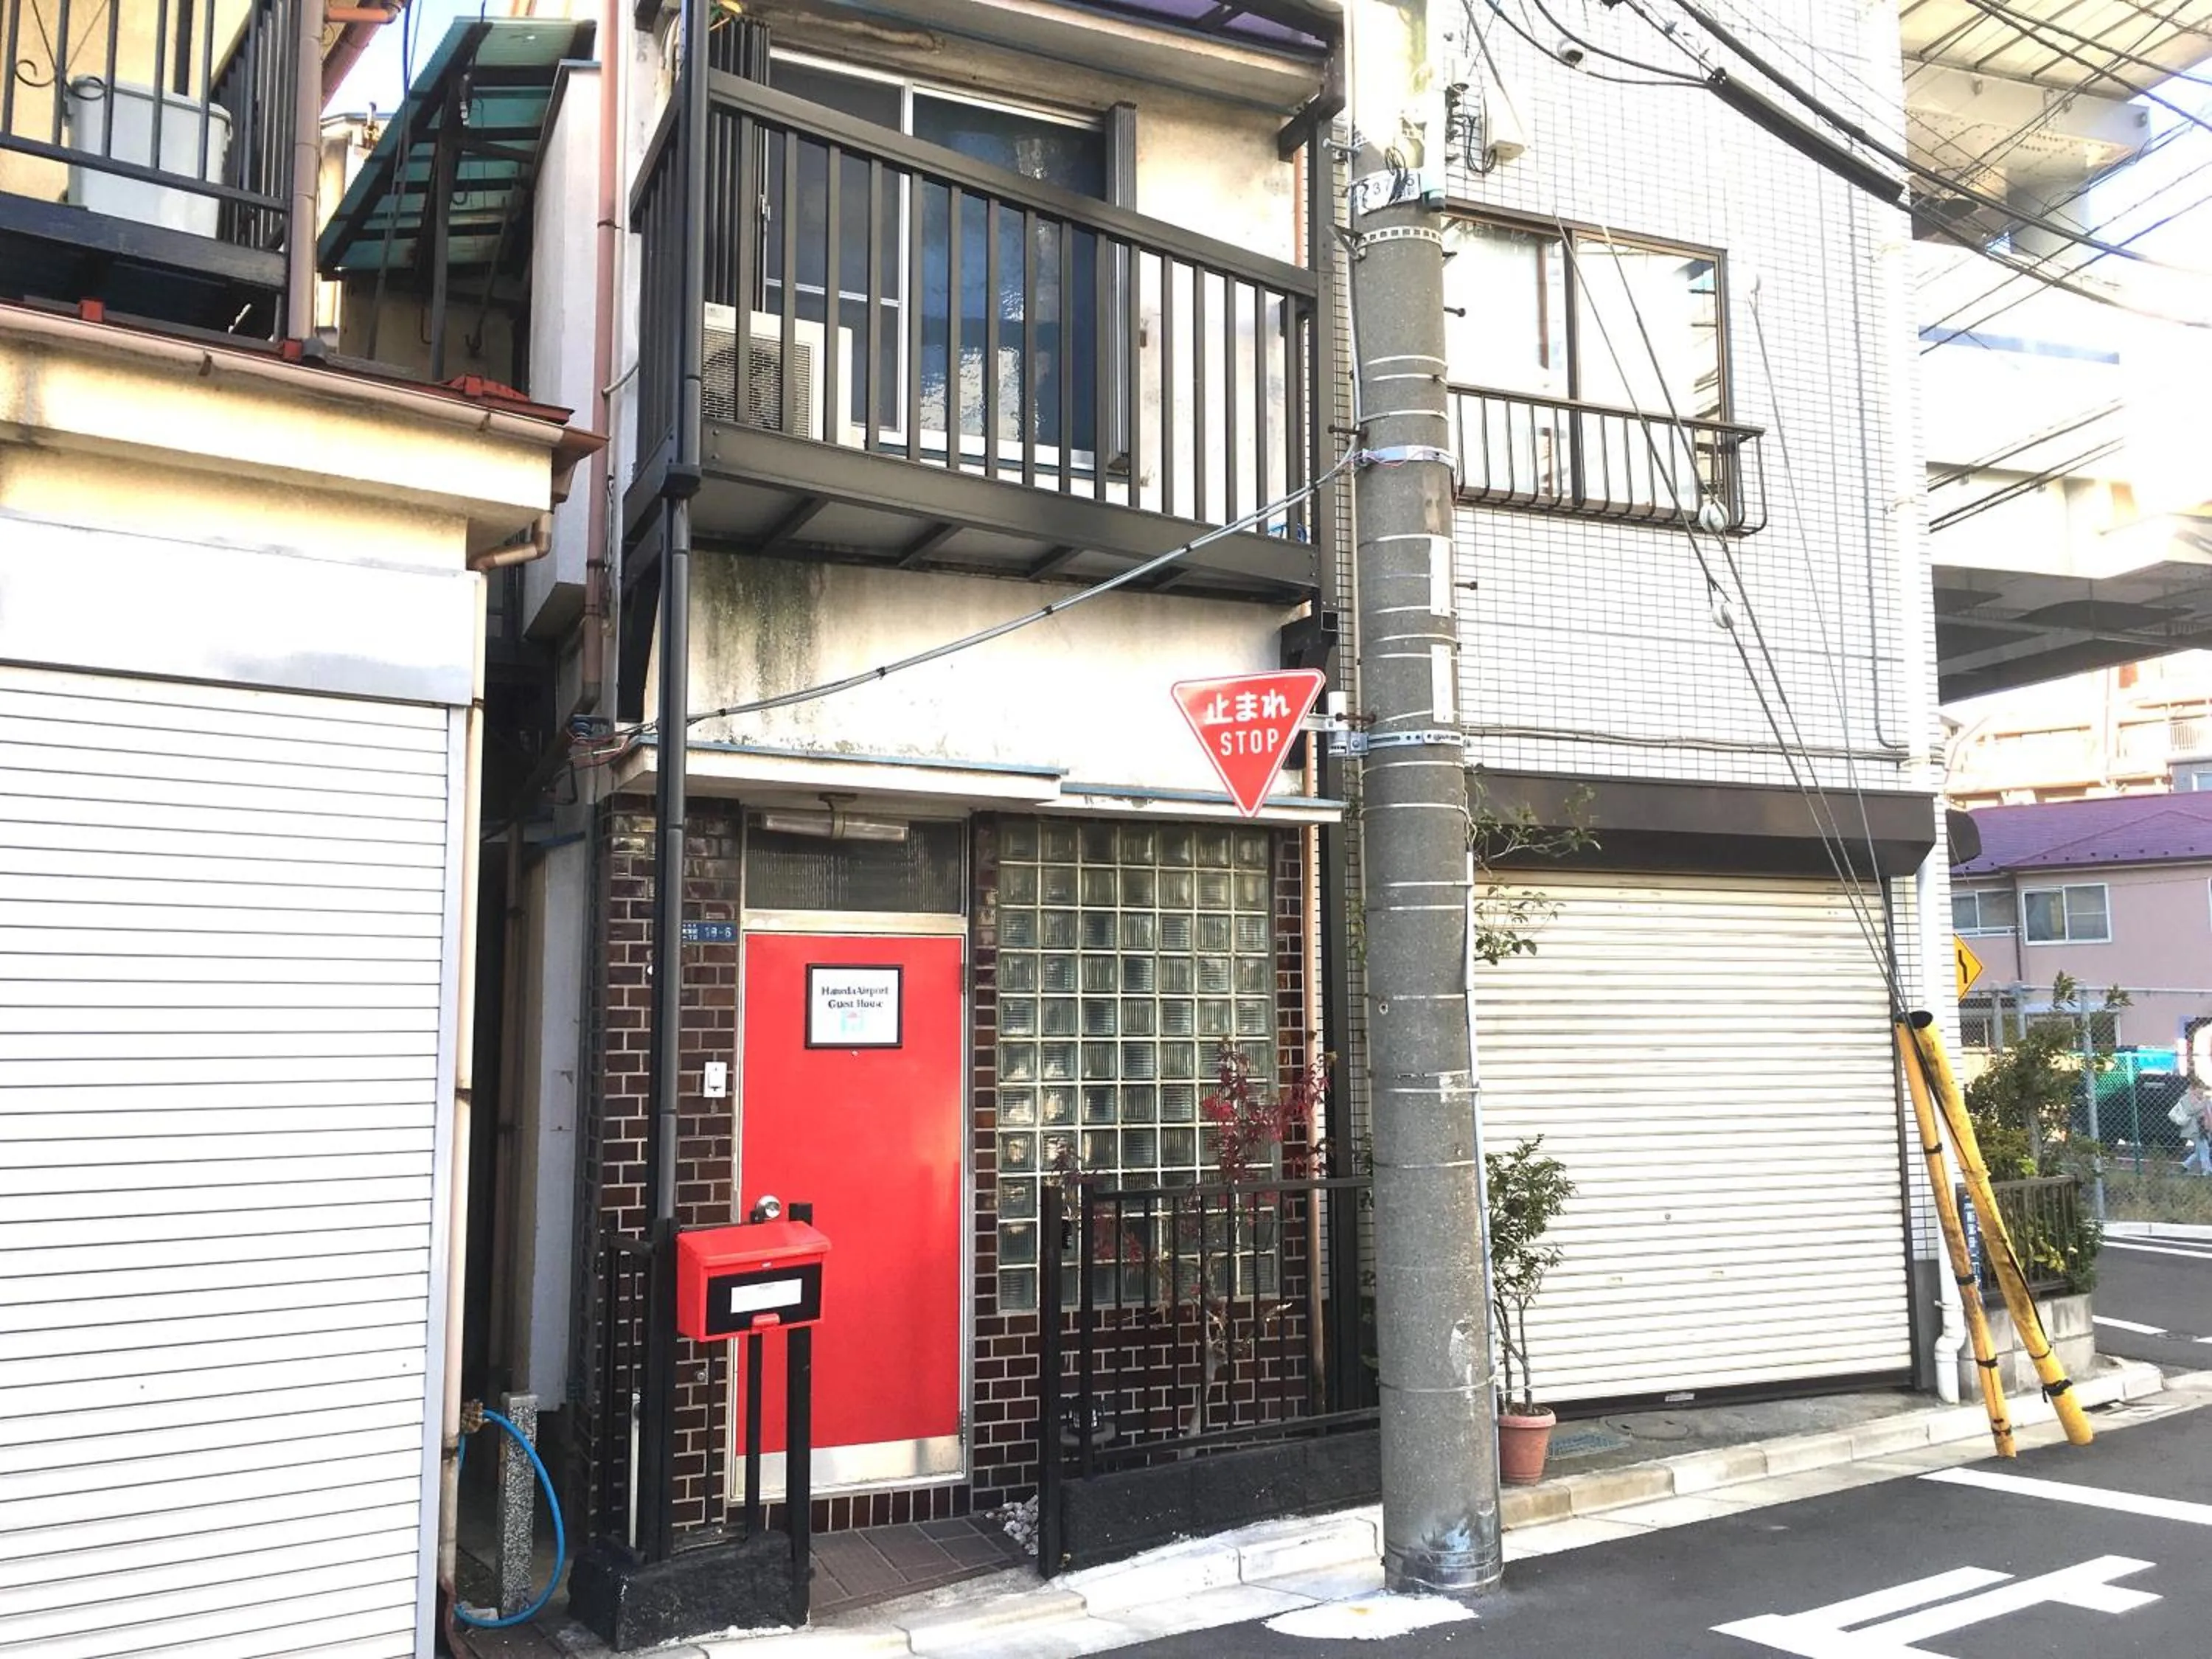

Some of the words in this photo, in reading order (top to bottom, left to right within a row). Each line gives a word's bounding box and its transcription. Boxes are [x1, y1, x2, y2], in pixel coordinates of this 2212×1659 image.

[1203, 688, 1291, 726] 止まれ
[1220, 728, 1279, 757] STOP
[821, 986, 856, 995] Haneda
[856, 987, 888, 997] Airport
[828, 999, 854, 1009] Guest
[857, 999, 883, 1008] House
